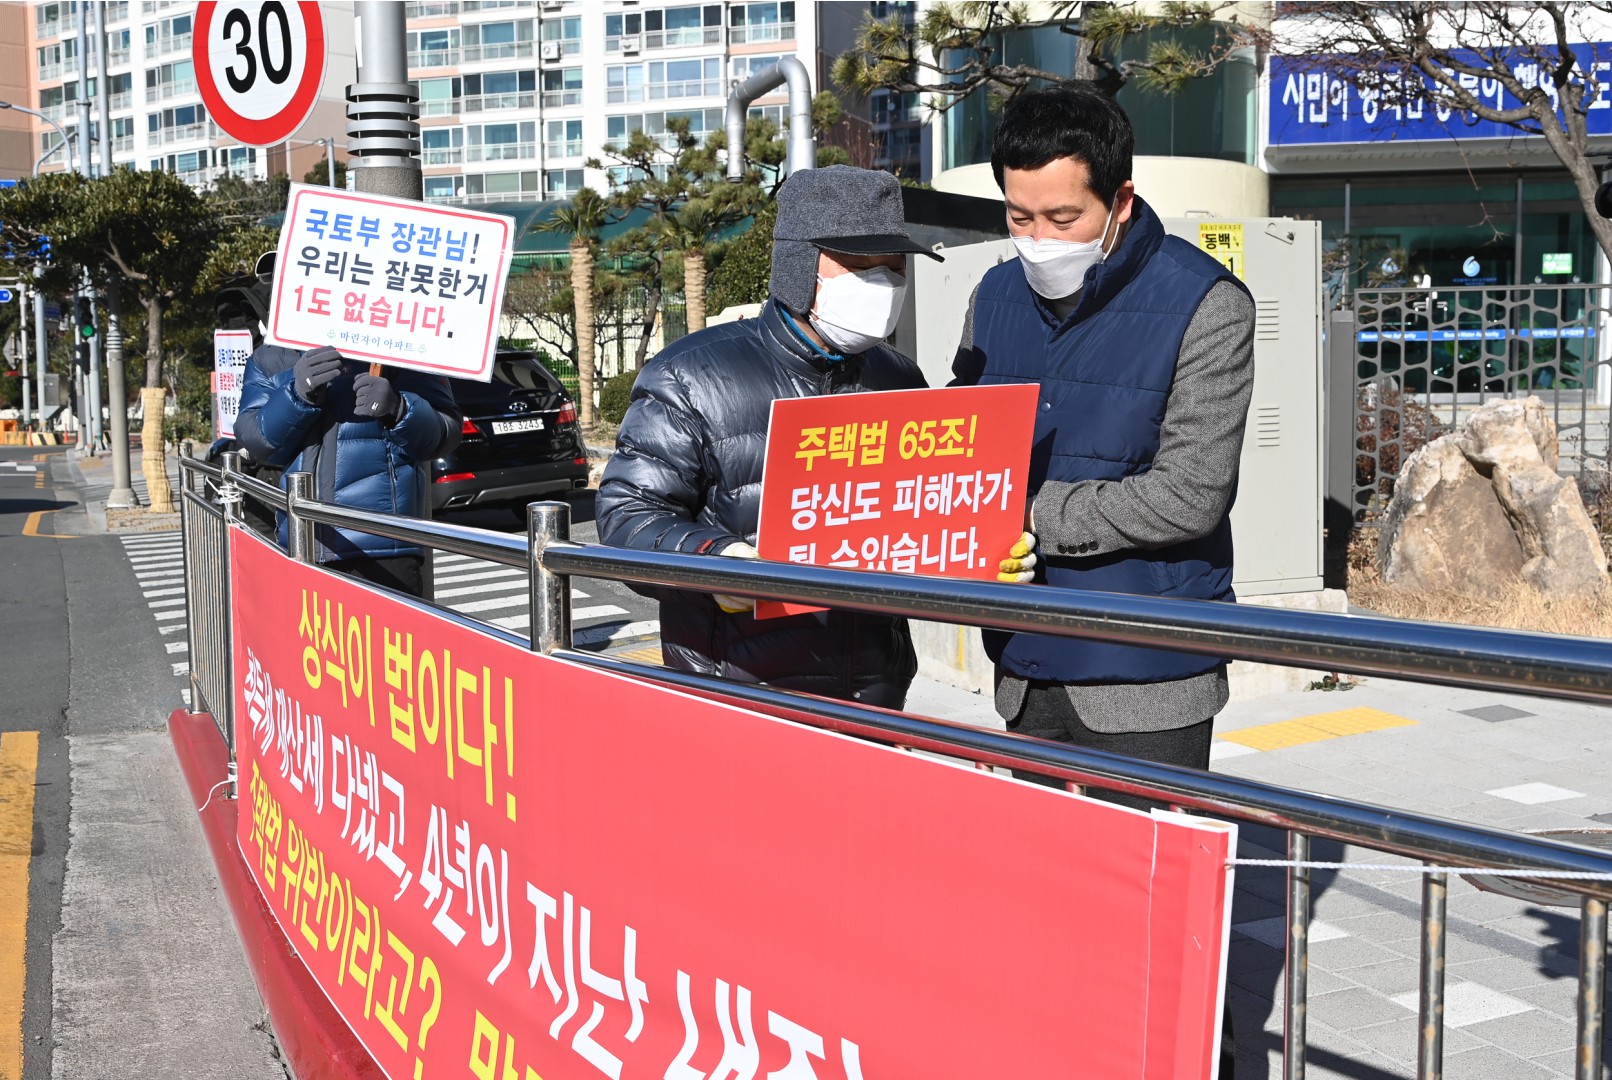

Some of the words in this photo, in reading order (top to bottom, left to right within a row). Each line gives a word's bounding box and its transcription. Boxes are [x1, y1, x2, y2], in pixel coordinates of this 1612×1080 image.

[223, 1, 292, 93] 30
[1283, 72, 1348, 123] 시민이
[305, 208, 380, 247] 국토부
[391, 221, 480, 264] 장관님!
[1205, 233, 1230, 250] 동백
[297, 245, 374, 286] 우리는
[385, 259, 488, 304] 잘못한거
[294, 284, 332, 316] 1도
[343, 291, 453, 338] 없습니다.
[340, 332, 381, 347] 마린자이
[384, 339, 414, 352] 아파트
[794, 420, 888, 471] 주택법
[898, 414, 977, 460] 65조!
[790, 481, 881, 531] 당신도
[893, 468, 1012, 518] 피해자가
[299, 589, 376, 727] 상식이
[383, 626, 517, 823] 법이다!
[274, 688, 324, 815] 재산세
[418, 803, 512, 986] 4년이
[526, 880, 649, 1080] 지난
[249, 758, 283, 893] 주택법
[281, 818, 442, 1080] 위반이라고?
